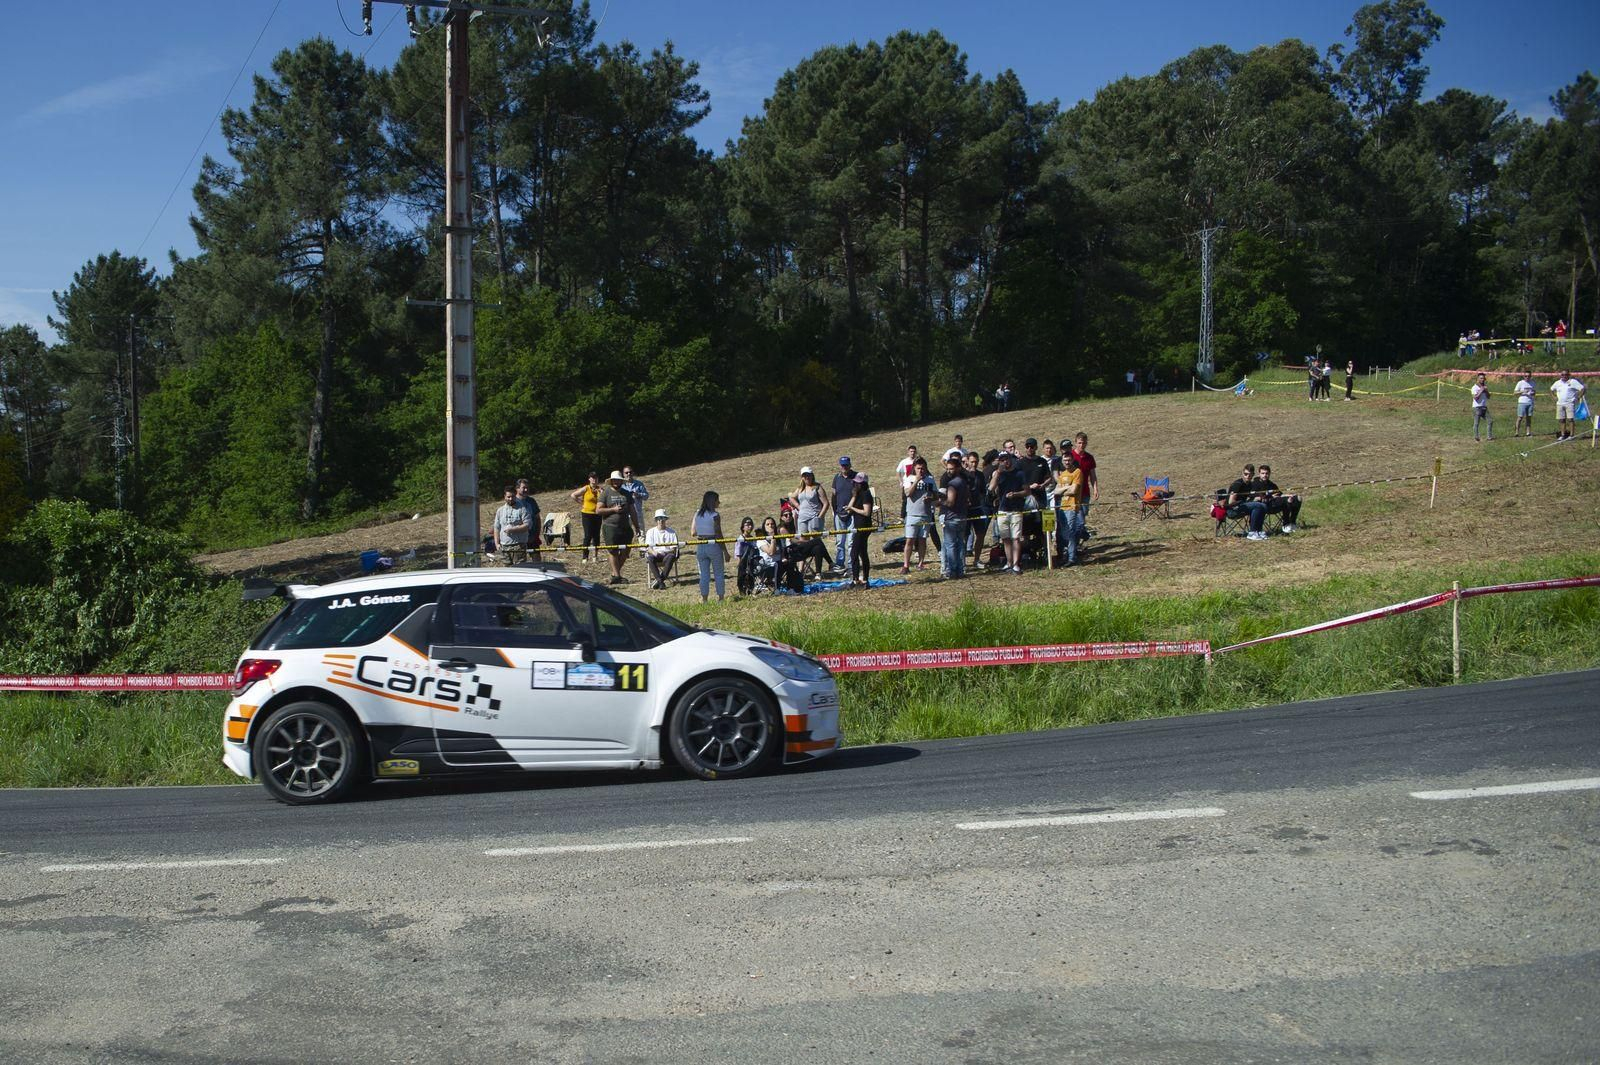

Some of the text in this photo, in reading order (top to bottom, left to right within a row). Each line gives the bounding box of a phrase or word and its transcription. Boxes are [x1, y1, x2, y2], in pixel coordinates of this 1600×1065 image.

[327, 593, 411, 610] J.A. Gómez
[906, 651, 962, 665] PROHIBIDO PUBLICO
[967, 648, 1024, 662] PROHIBIDO PUBLICO
[1029, 645, 1086, 658] PROHIBIDO PUBLICO
[845, 654, 901, 668] PROHIBIDO PUBLICO
[79, 676, 123, 687] PROHIBIDO PUBLICO
[127, 676, 173, 687] PROHIBIDO PUBLICO
[177, 675, 202, 686] PROHIBIDO
[202, 675, 224, 686] PUBLICO
[356, 655, 462, 702] Cars
[617, 664, 645, 689] 11
[464, 707, 500, 720] Rallye
